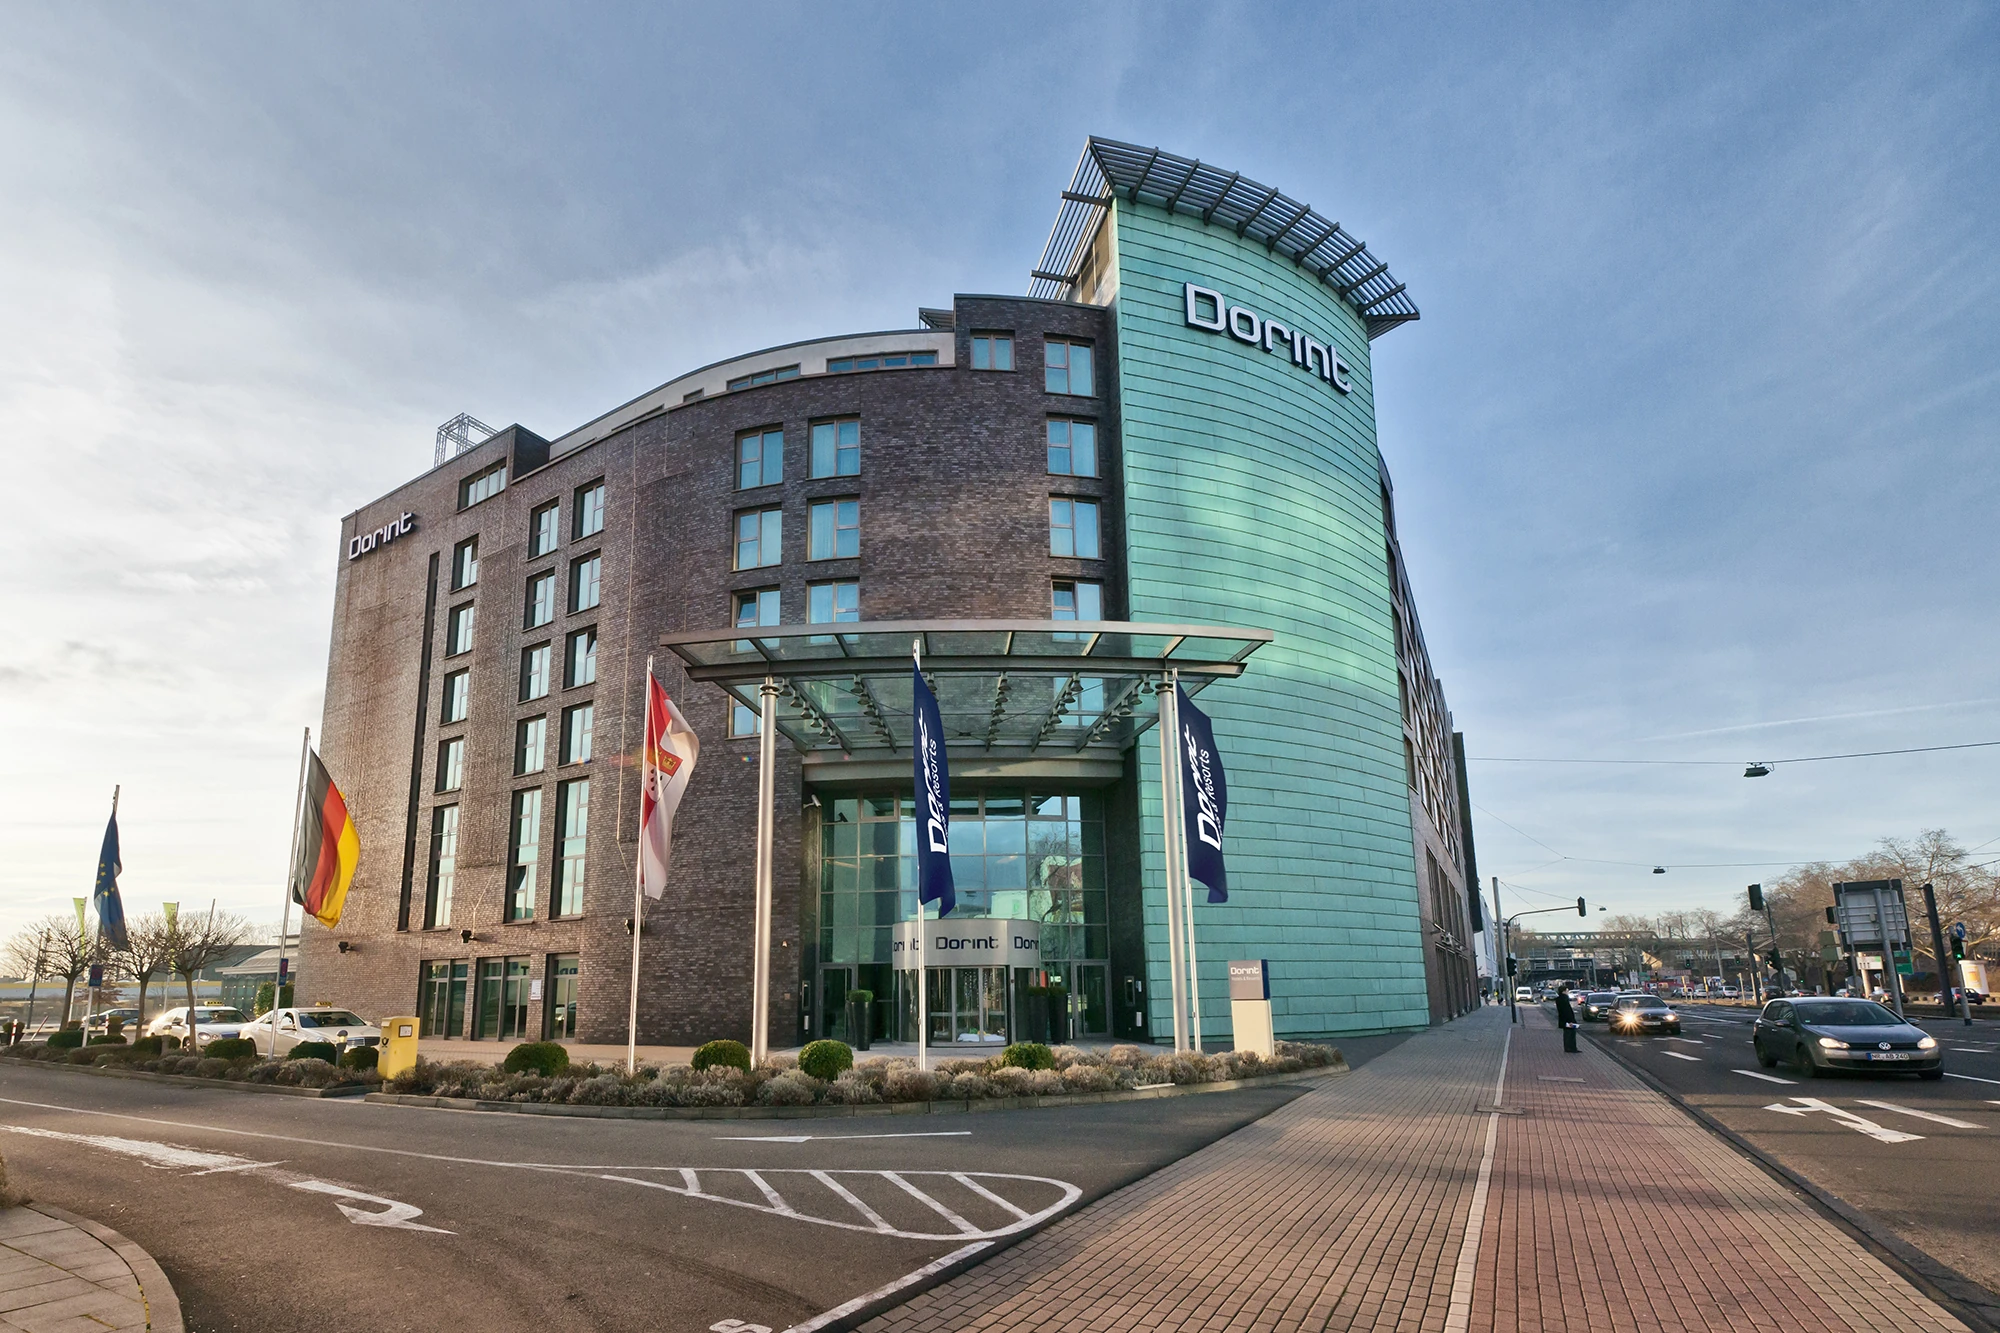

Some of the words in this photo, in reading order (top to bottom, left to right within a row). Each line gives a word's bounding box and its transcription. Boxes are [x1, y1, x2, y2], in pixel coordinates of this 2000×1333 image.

[1183, 281, 1353, 395] Dorint
[348, 511, 413, 560] Dorint
[935, 935, 999, 950] Dorint
[1230, 966, 1260, 975] Dorint
